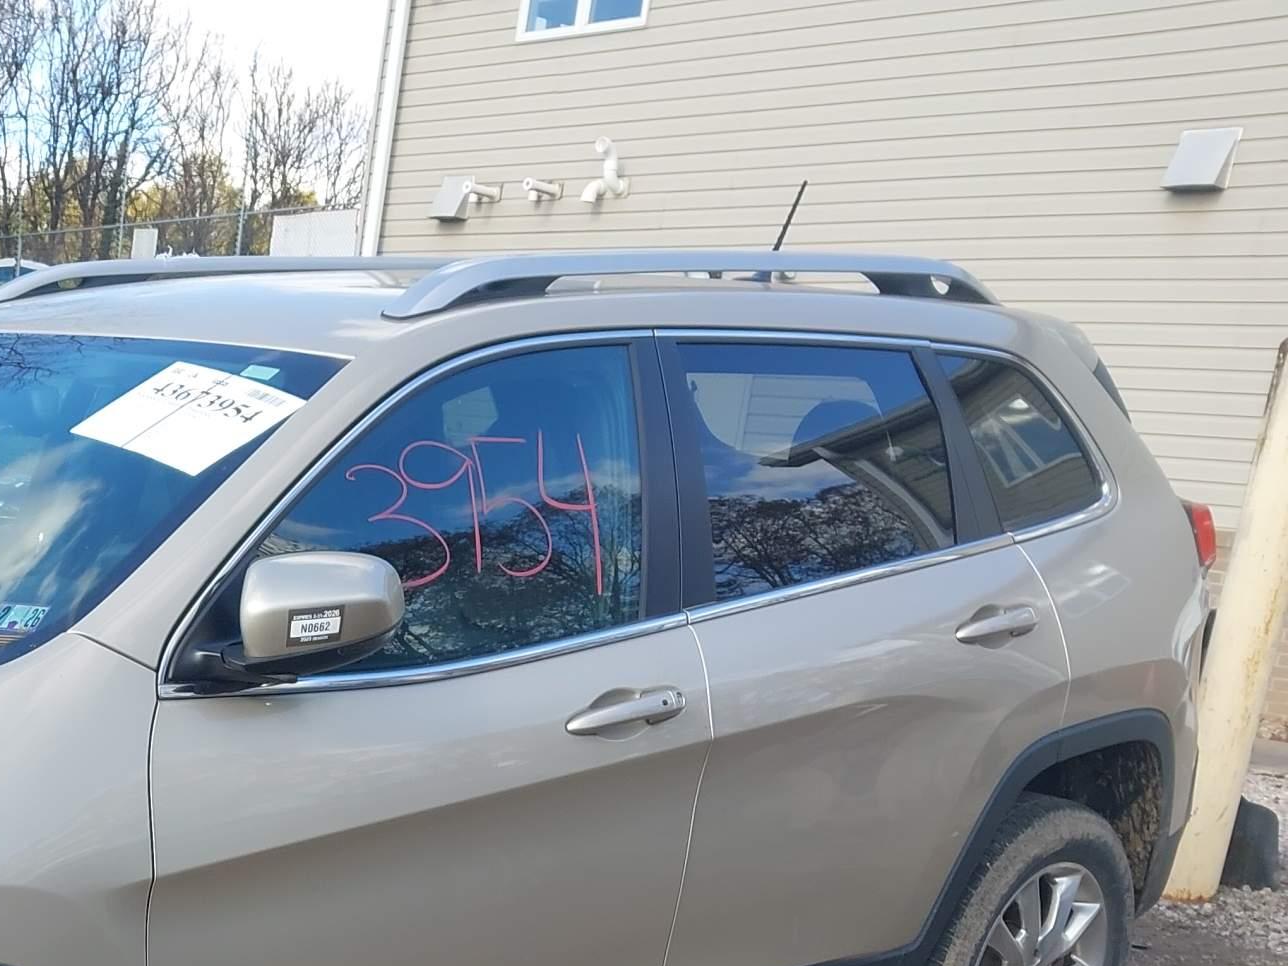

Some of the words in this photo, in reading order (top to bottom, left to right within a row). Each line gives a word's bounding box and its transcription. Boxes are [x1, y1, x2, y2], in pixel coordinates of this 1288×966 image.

[152, 381, 264, 424] 43673954
[345, 427, 604, 596] 3954
[24, 608, 46, 628] 26
[300, 621, 331, 634] N0662
